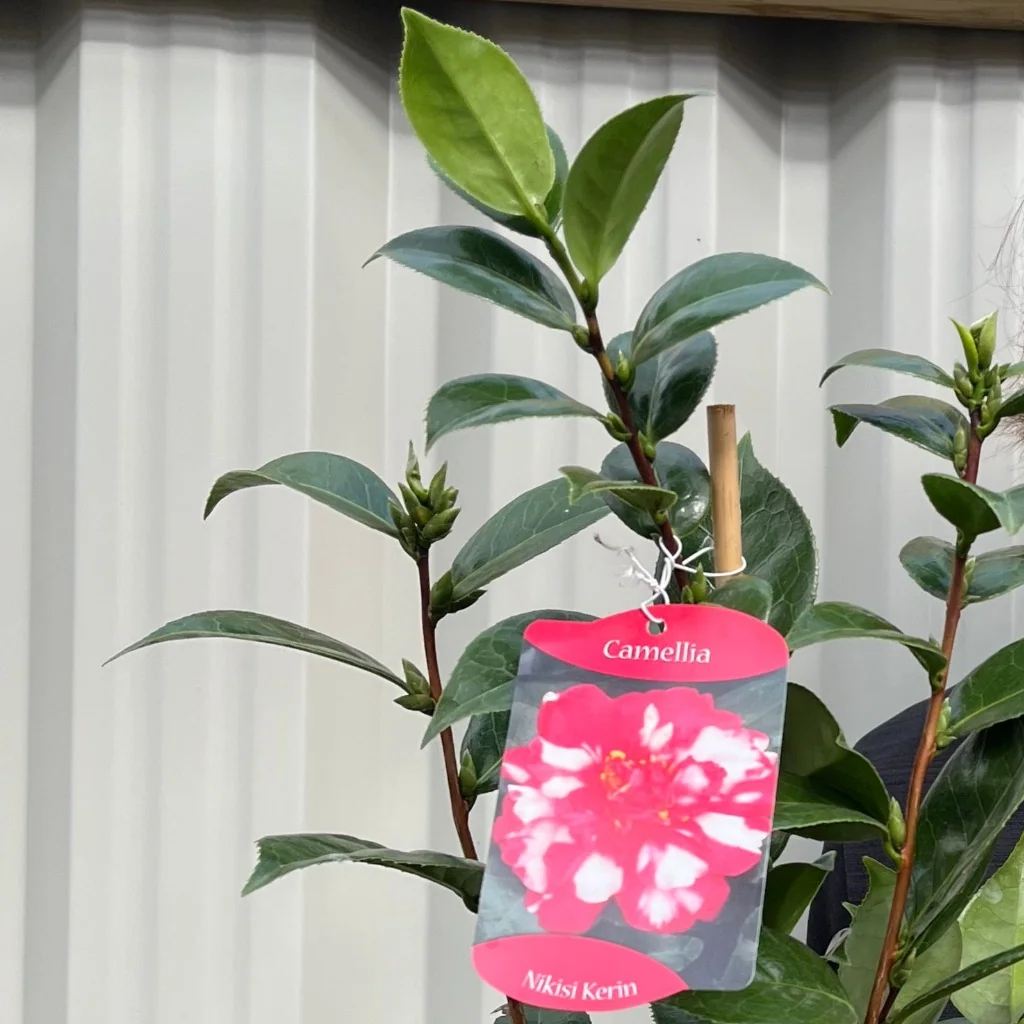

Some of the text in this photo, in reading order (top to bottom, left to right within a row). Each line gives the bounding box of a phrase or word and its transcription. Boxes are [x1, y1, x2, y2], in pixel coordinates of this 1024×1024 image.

[602, 639, 711, 663] Camellia
[521, 969, 638, 1000] Nikisi Kerin
